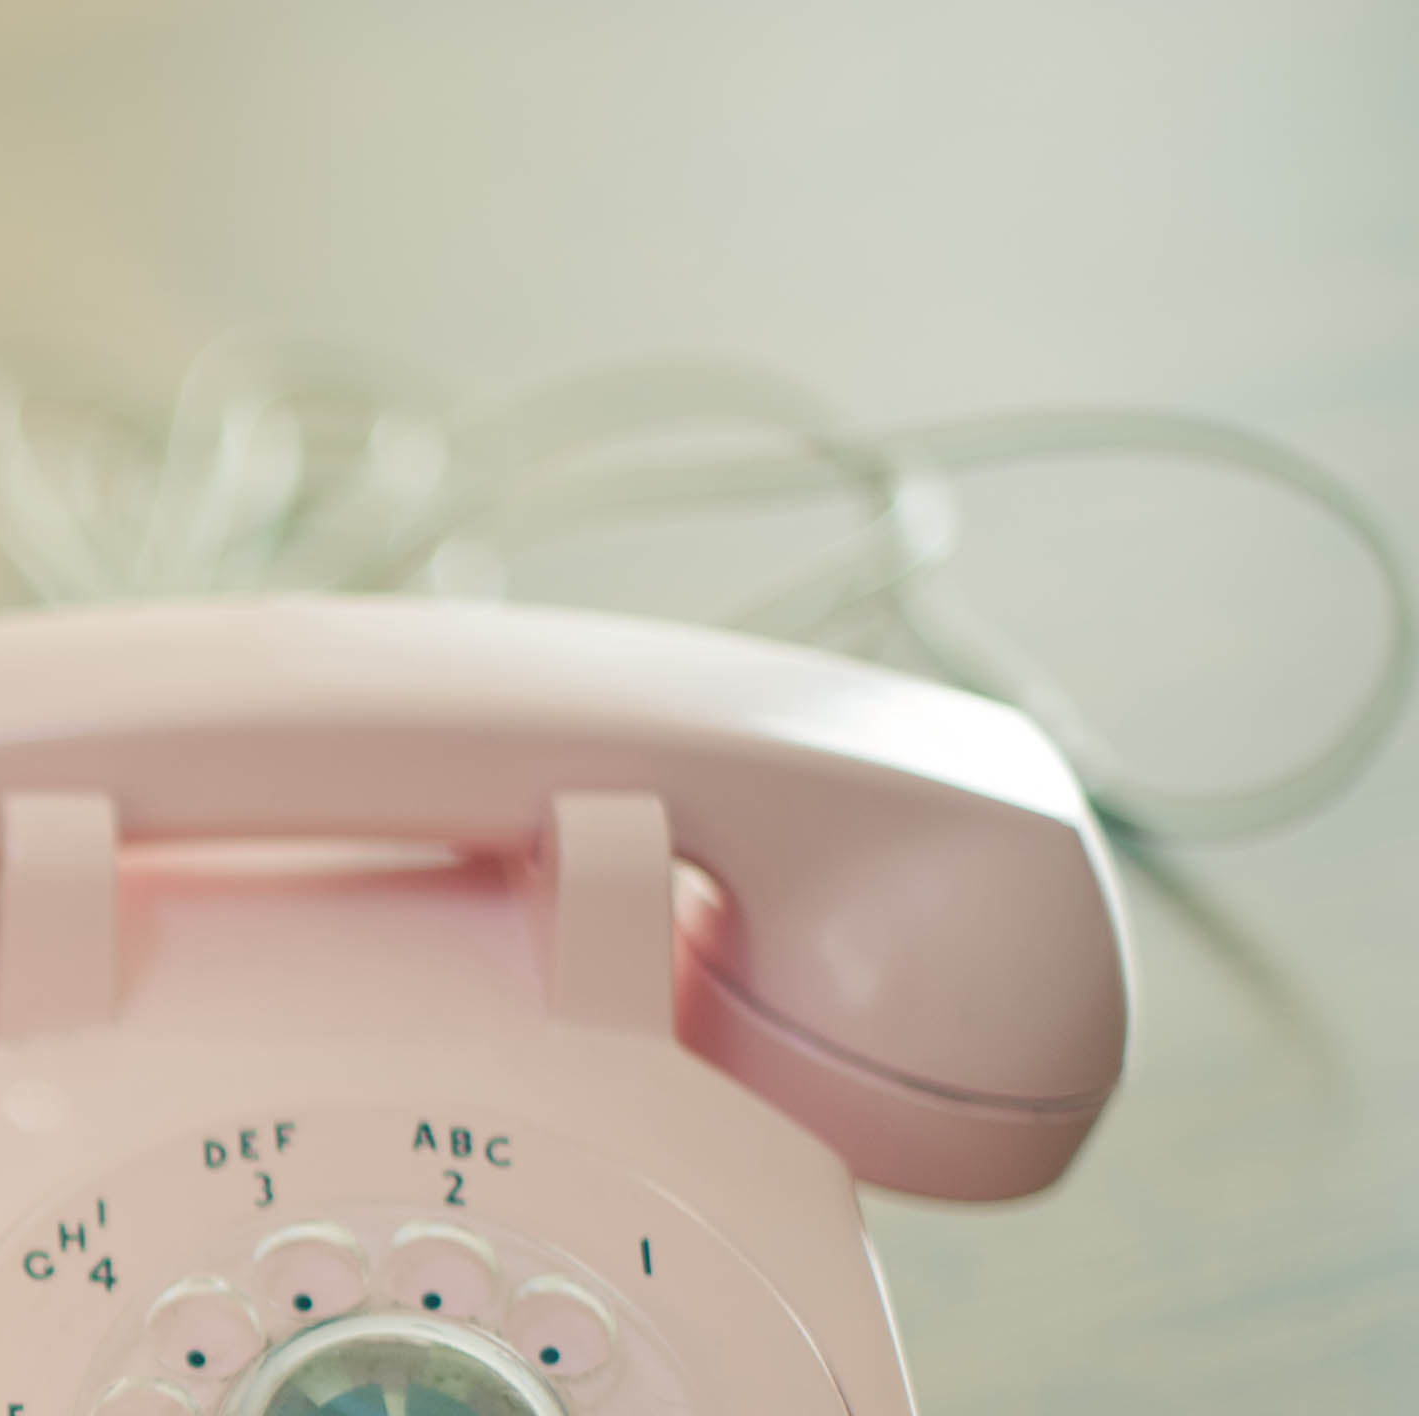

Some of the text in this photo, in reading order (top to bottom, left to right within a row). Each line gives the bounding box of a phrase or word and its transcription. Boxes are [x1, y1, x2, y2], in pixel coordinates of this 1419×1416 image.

[203, 1121, 295, 1169] DEF
[412, 1120, 513, 1168] ABC
[254, 1171, 275, 1208] 3
[443, 1169, 466, 1206] 2
[89, 1257, 118, 1292] 4
